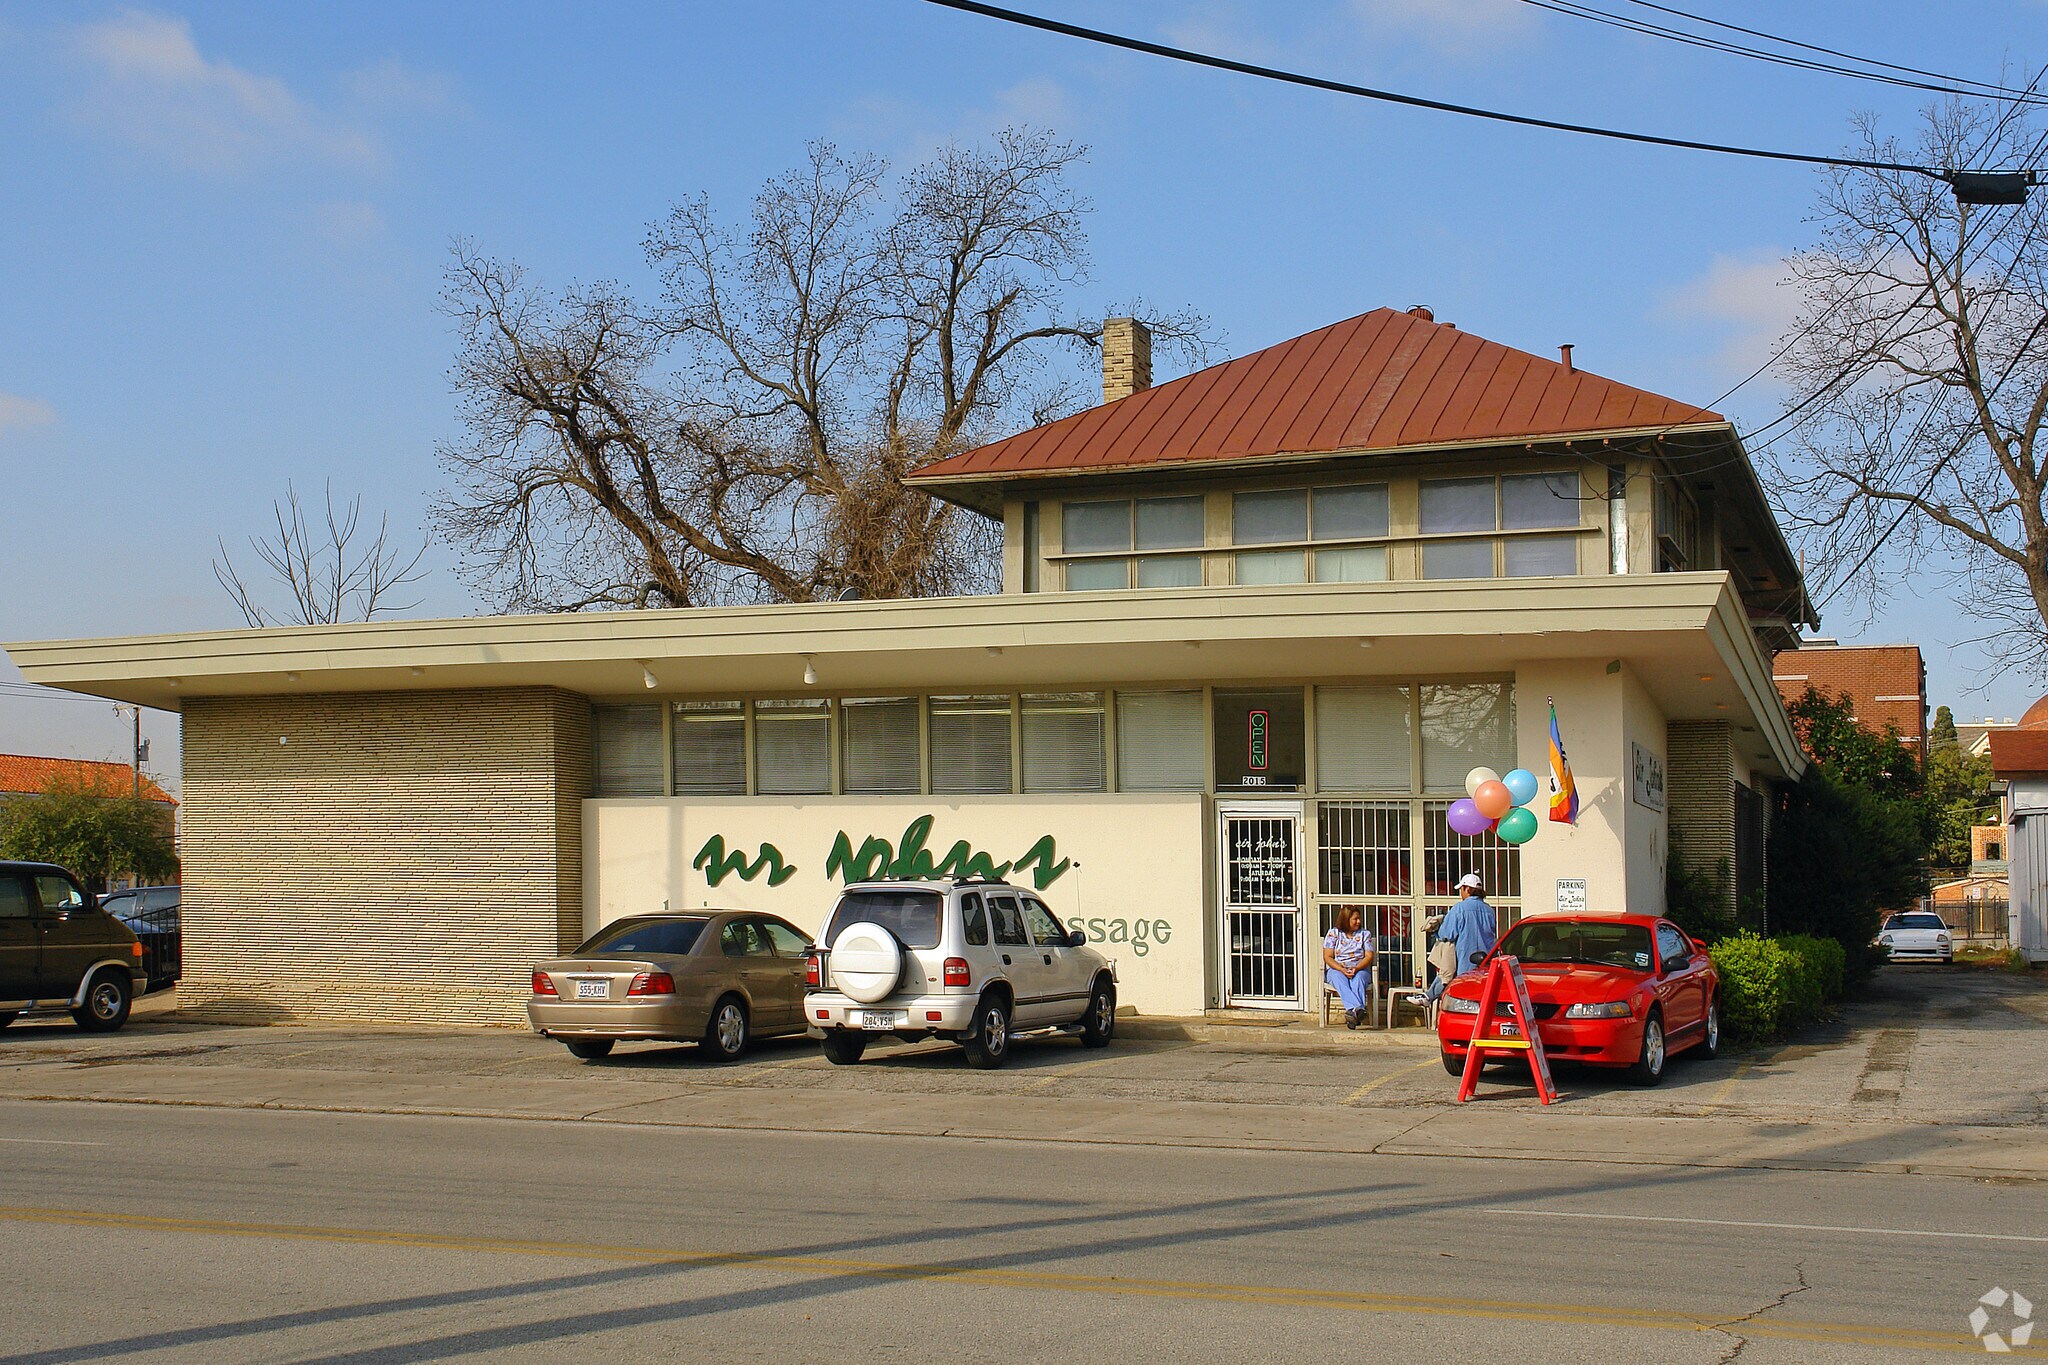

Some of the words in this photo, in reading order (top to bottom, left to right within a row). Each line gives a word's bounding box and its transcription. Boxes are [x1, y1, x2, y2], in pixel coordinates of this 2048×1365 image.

[1251, 714, 1265, 766] OPEN
[1243, 776, 1266, 785] 2015
[1558, 881, 1585, 889] PARKING
